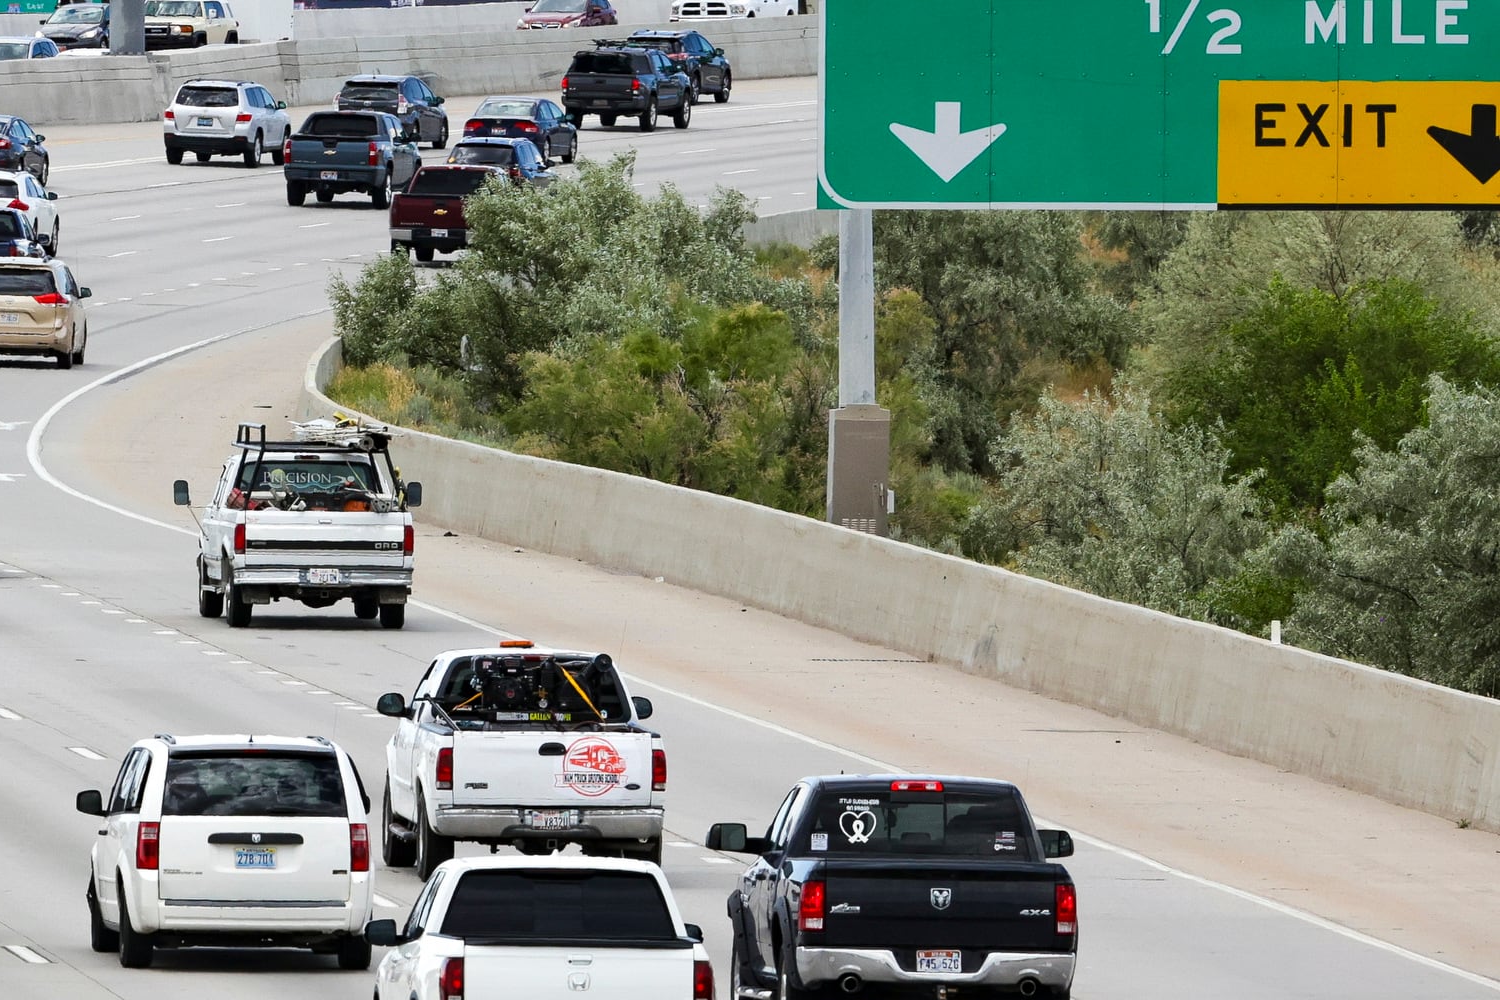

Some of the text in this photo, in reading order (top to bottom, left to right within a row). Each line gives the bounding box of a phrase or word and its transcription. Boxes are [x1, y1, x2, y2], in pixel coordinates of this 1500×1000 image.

[1144, 0, 1469, 54] 1/2 MILE
[1254, 103, 1397, 148] EXIT
